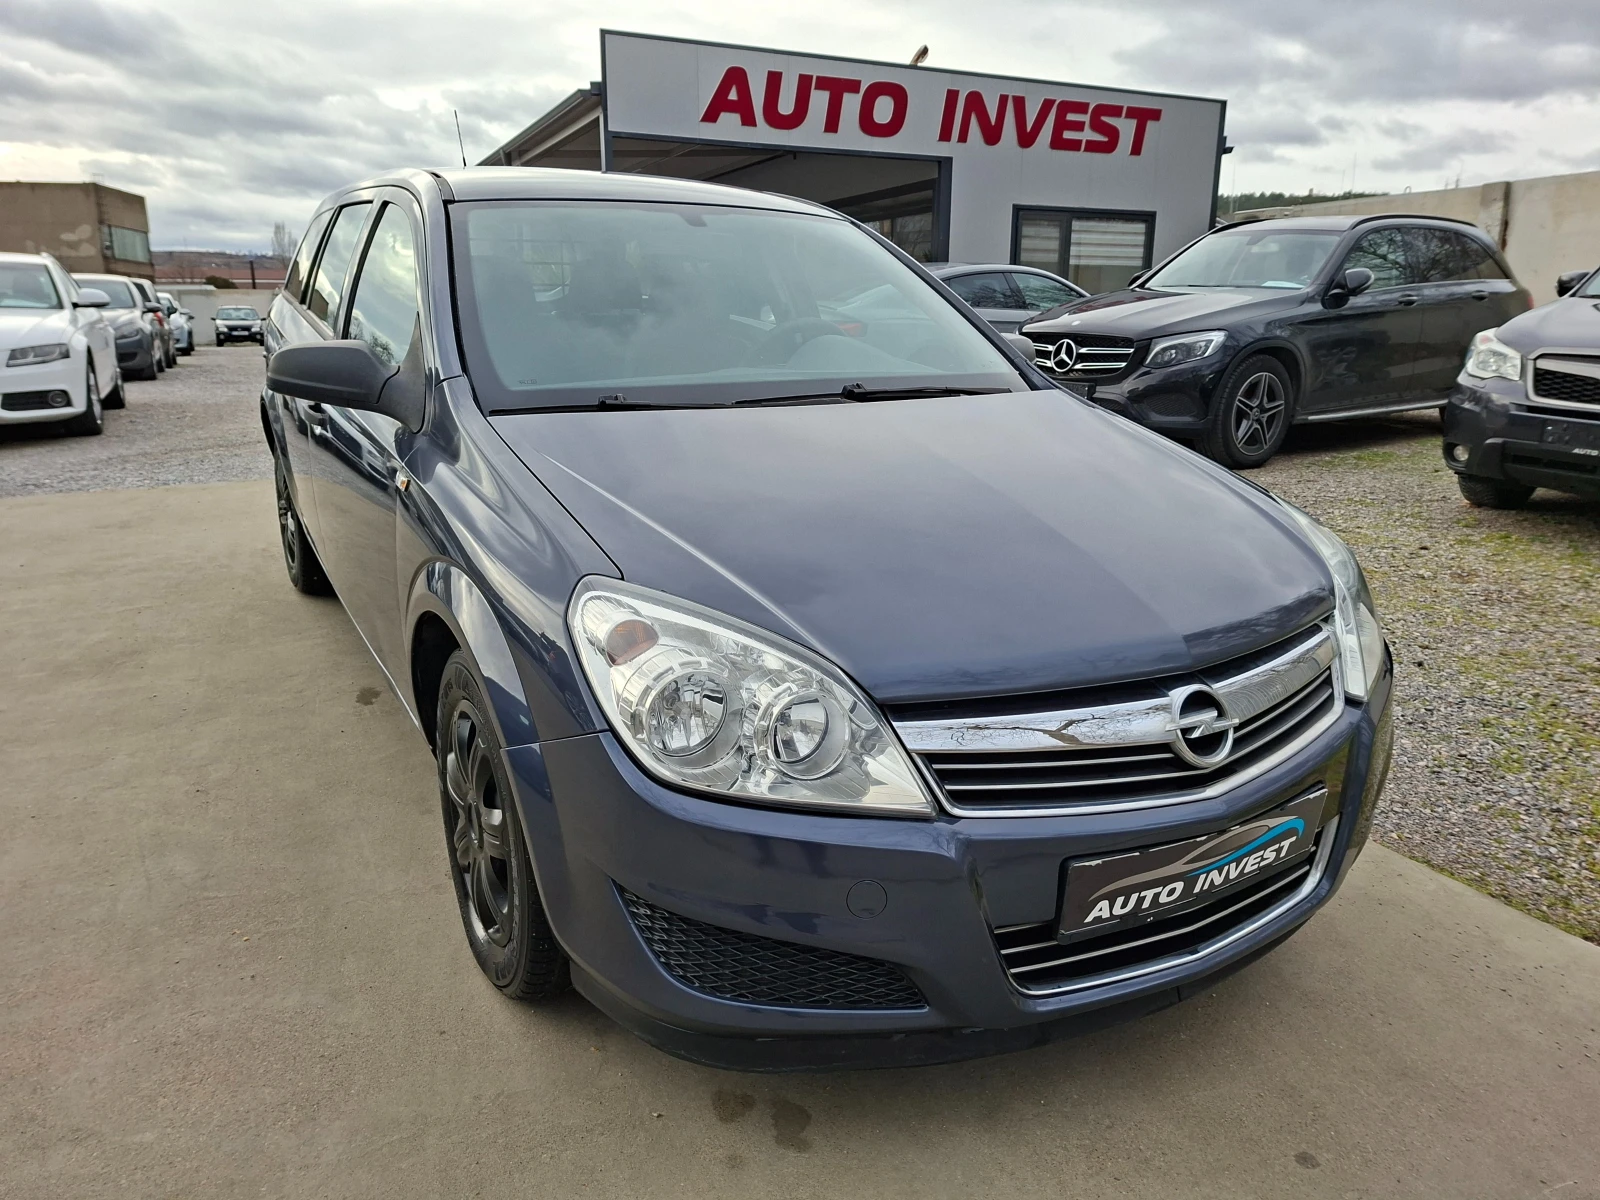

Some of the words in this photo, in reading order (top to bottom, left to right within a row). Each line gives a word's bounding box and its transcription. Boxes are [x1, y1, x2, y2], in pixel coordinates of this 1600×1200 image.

[701, 66, 908, 137] AUTO
[937, 89, 1162, 156] INVEST
[1571, 447, 1599, 456] AUTO
[1083, 881, 1185, 923] AUTO
[1192, 835, 1297, 894] INVEST
